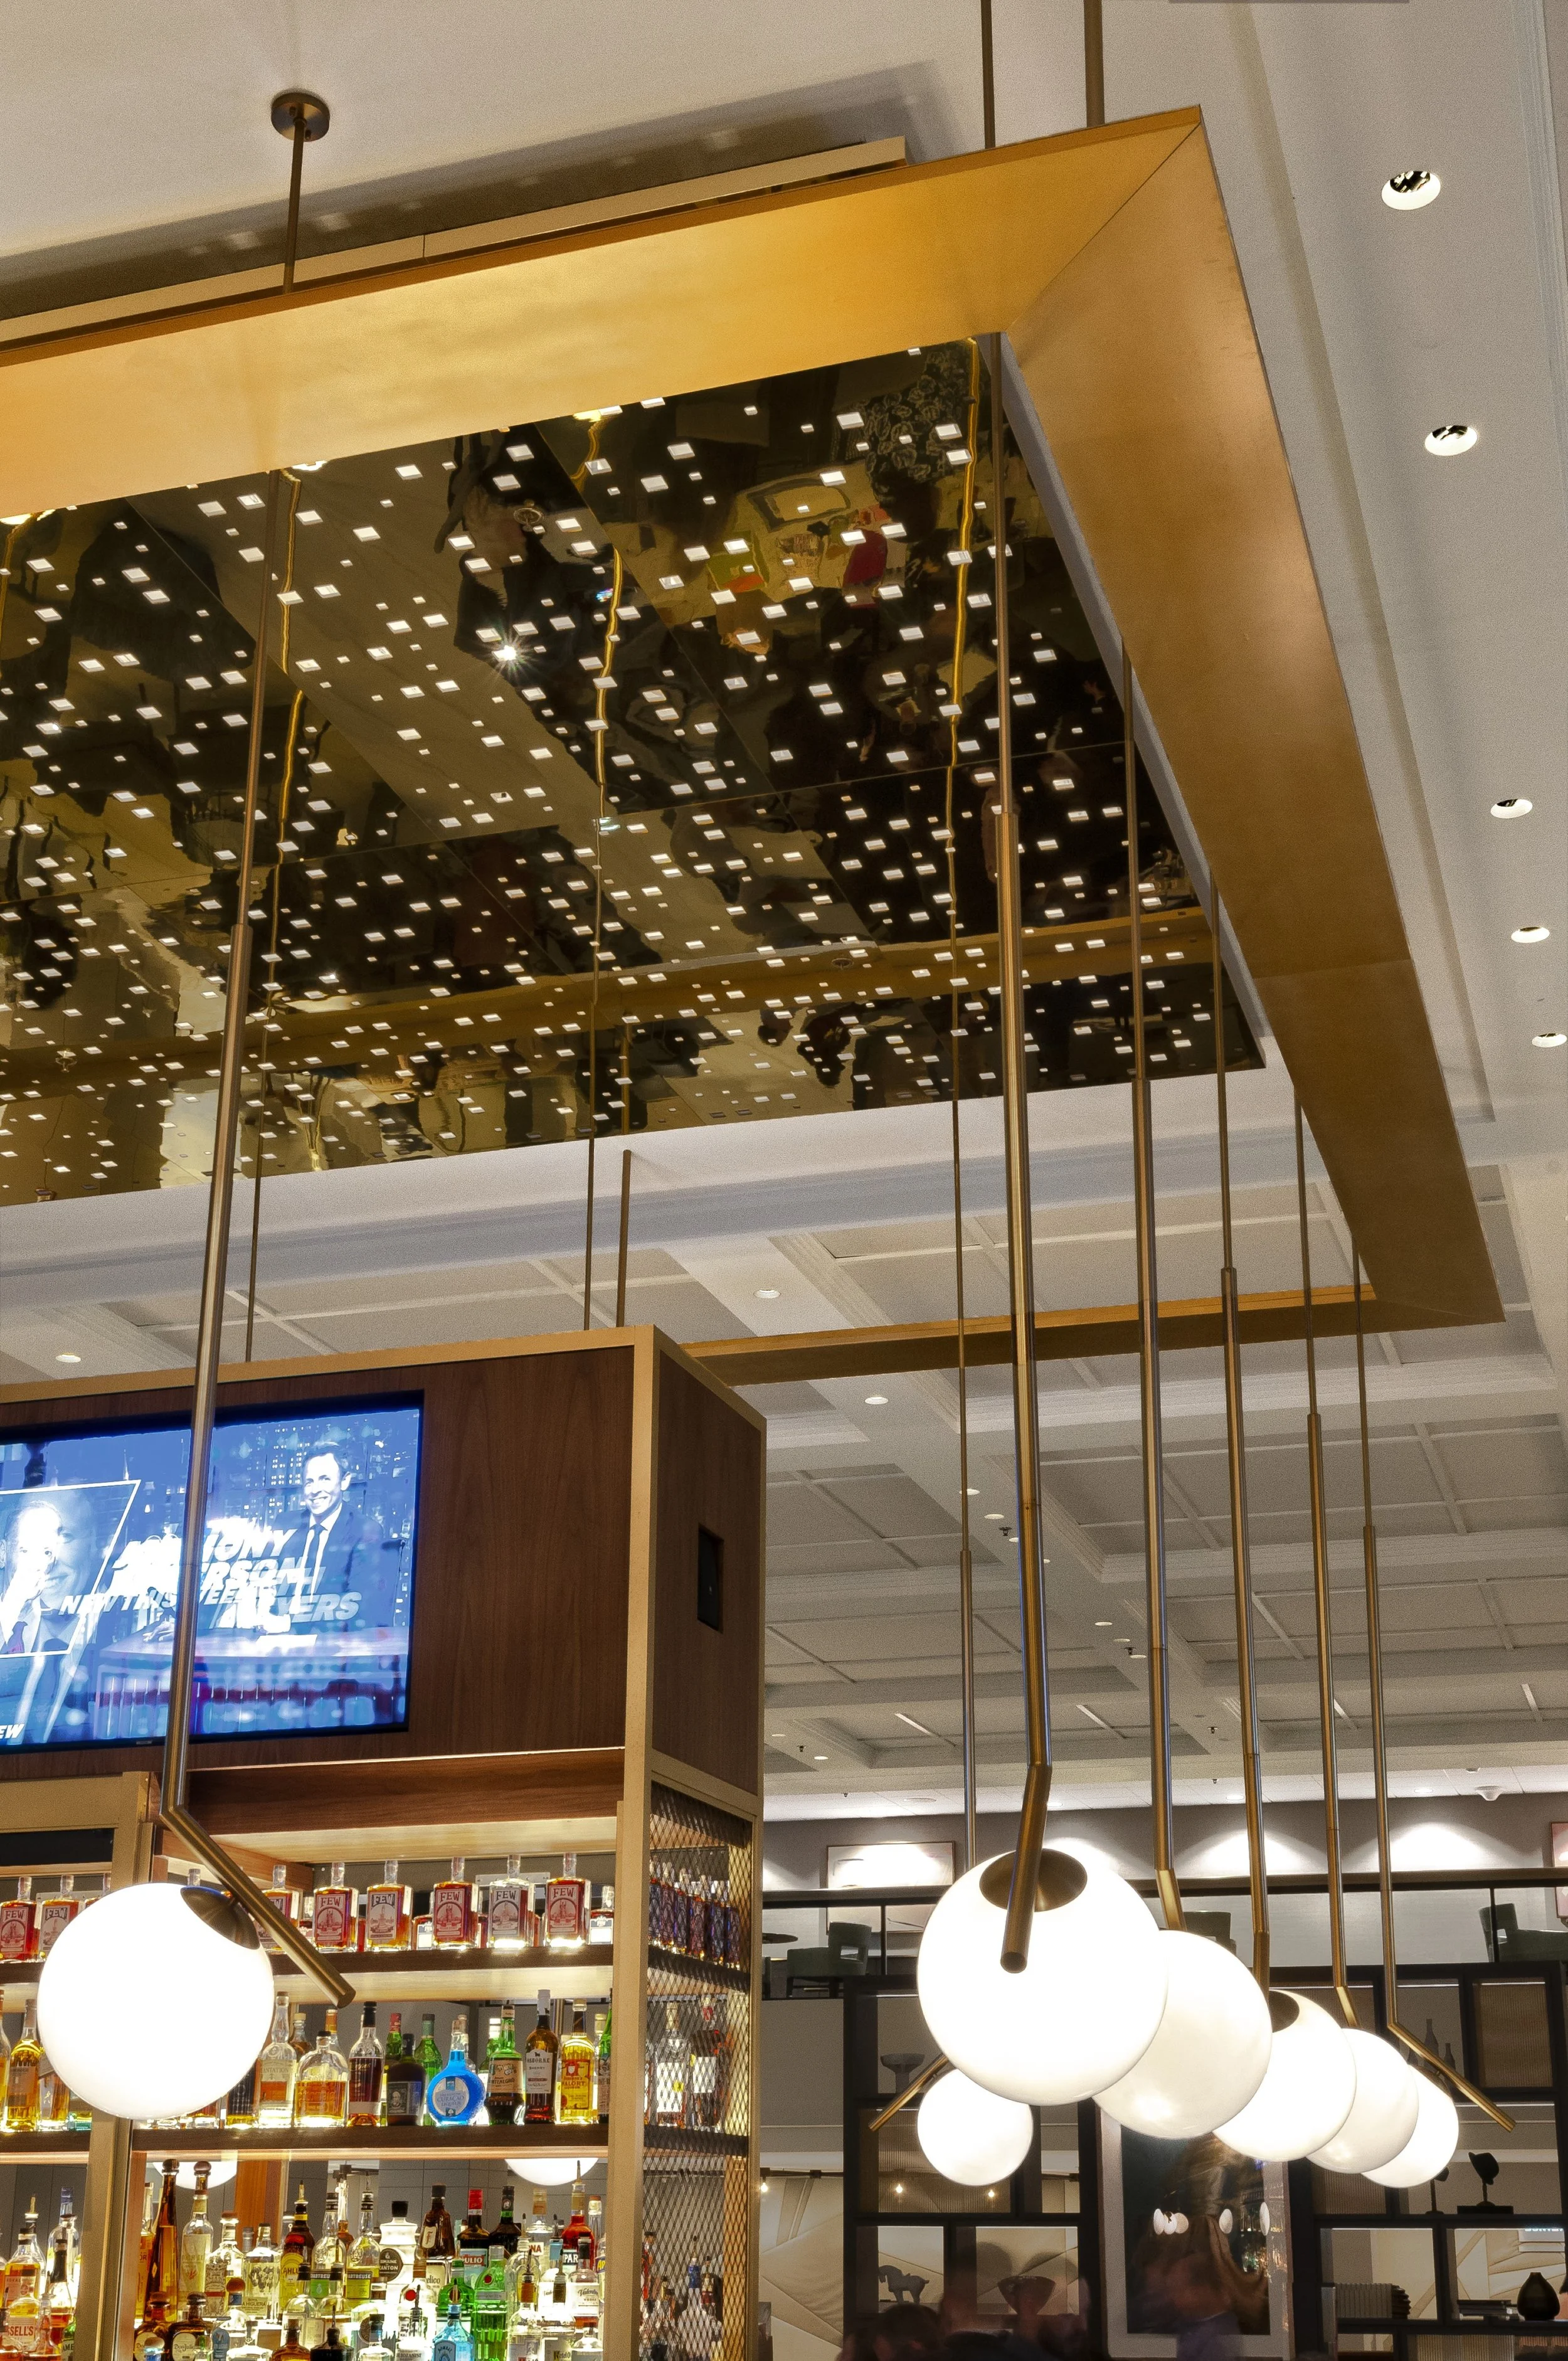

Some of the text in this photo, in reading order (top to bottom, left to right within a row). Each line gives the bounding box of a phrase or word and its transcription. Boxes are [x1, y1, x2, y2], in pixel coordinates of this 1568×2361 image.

[0, 1724, 24, 1739] EW
[440, 1891, 461, 1902] FEW
[495, 1890, 517, 1901] FEW
[553, 1887, 575, 1899] FEW
[320, 1897, 341, 1907] FEW
[373, 1894, 394, 1907] FEW
[5, 1910, 24, 1920] FEW
[46, 1907, 67, 1918] FEW
[563, 2254, 578, 2263] PAR
[8, 2326, 34, 2337] SSELL'S
